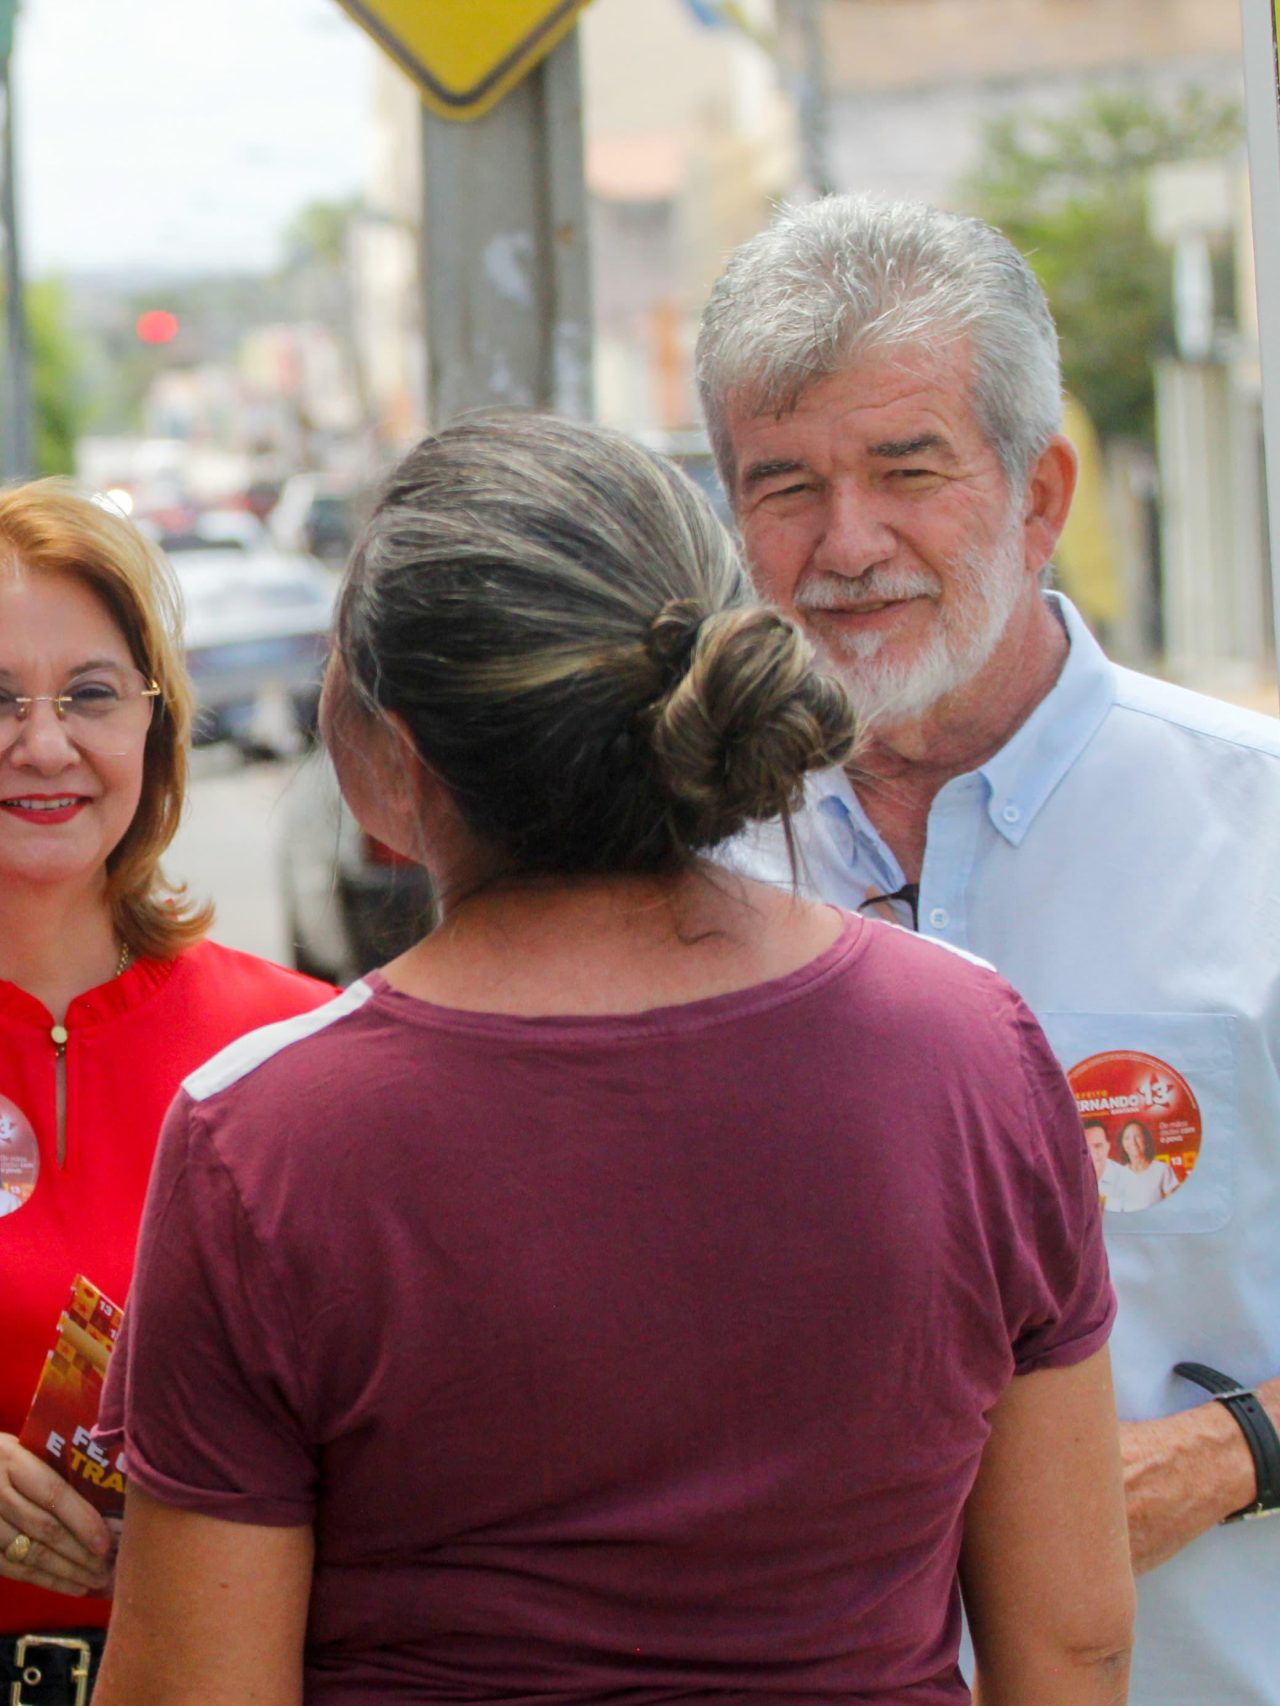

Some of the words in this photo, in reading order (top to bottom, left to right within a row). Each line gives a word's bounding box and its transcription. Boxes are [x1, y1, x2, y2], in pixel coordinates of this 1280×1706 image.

[1078, 1095, 1140, 1112] RNANDO
[1138, 1079, 1171, 1106] 13
[100, 1300, 113, 1317] 13
[45, 1430, 66, 1459] E
[71, 1446, 126, 1494] TRA
